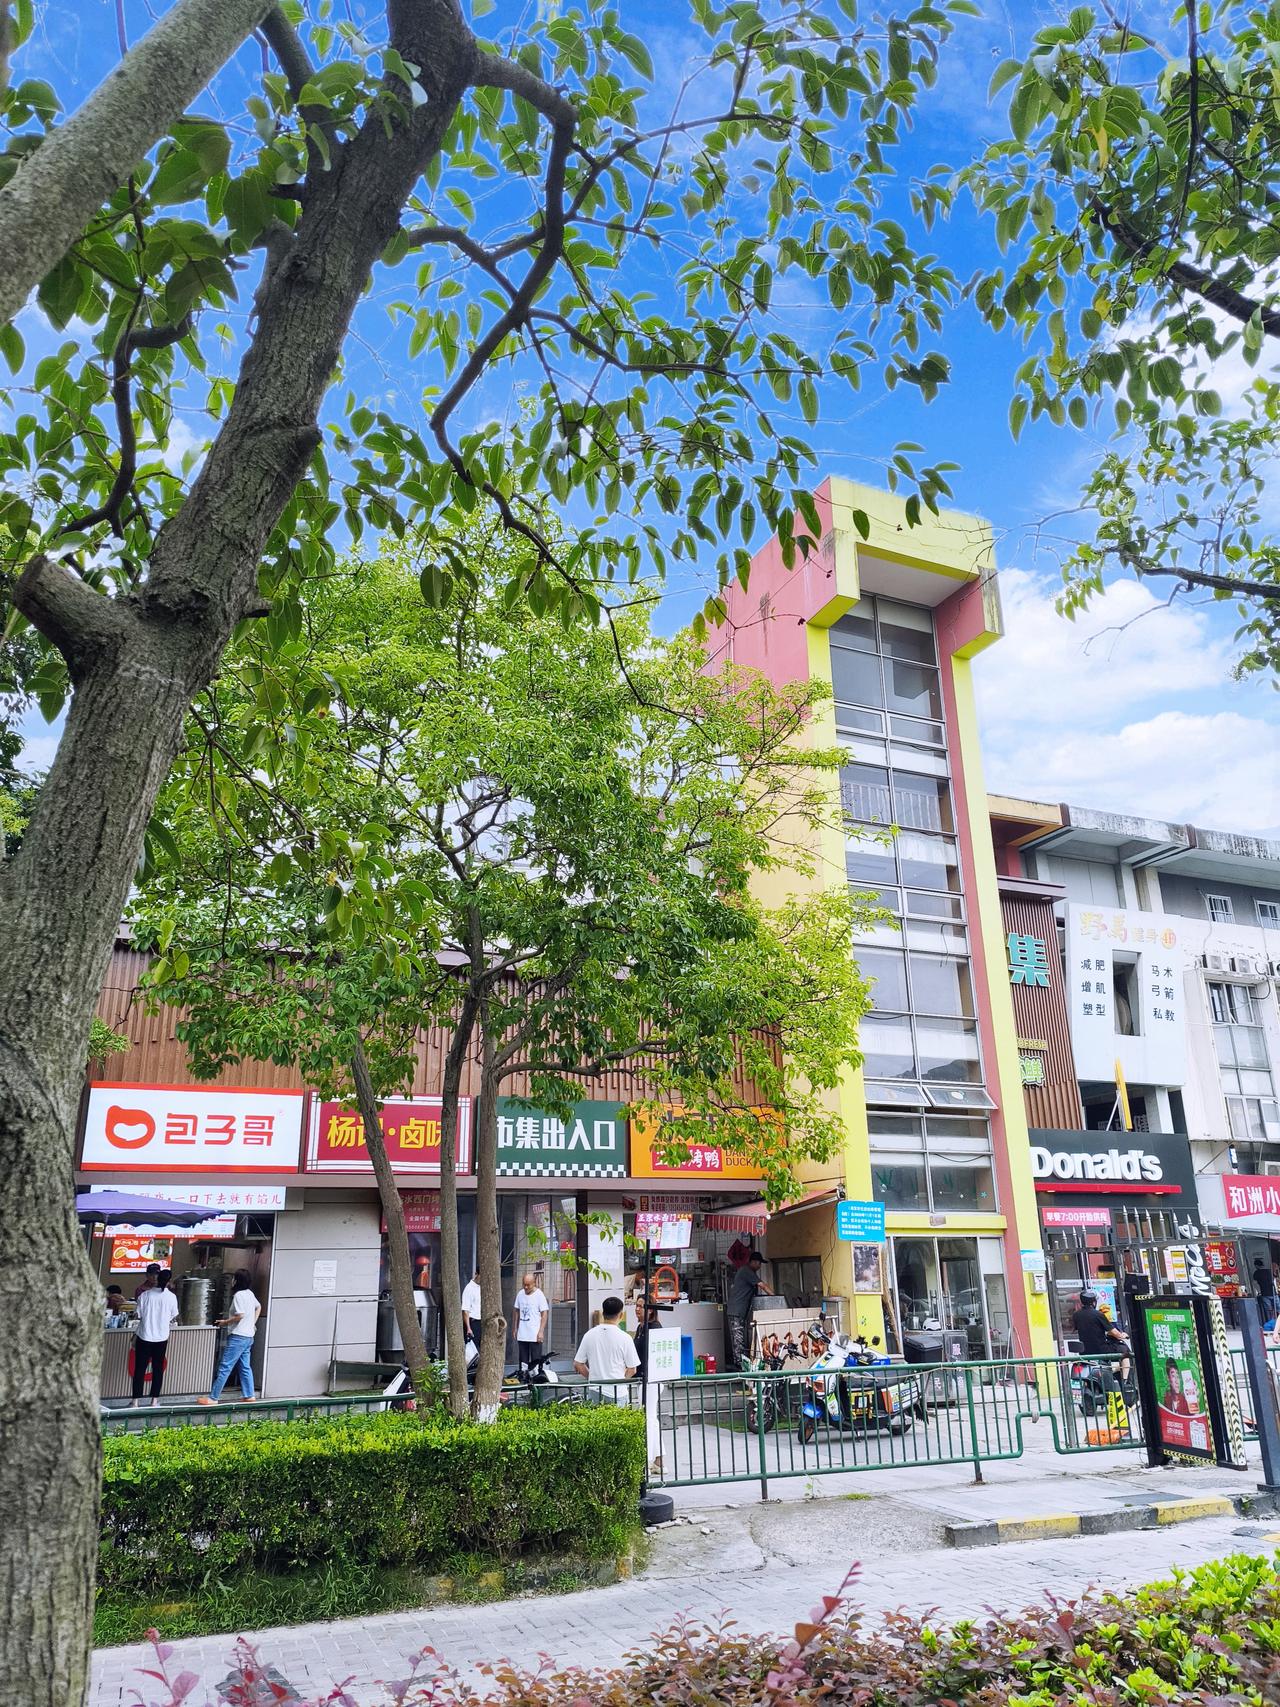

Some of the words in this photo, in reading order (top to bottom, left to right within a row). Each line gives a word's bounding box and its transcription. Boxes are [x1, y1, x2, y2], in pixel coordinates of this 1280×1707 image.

[1007, 932, 1050, 987] 集
[164, 1112, 275, 1147] 包子哥
[726, 1157, 753, 1166] DUCK
